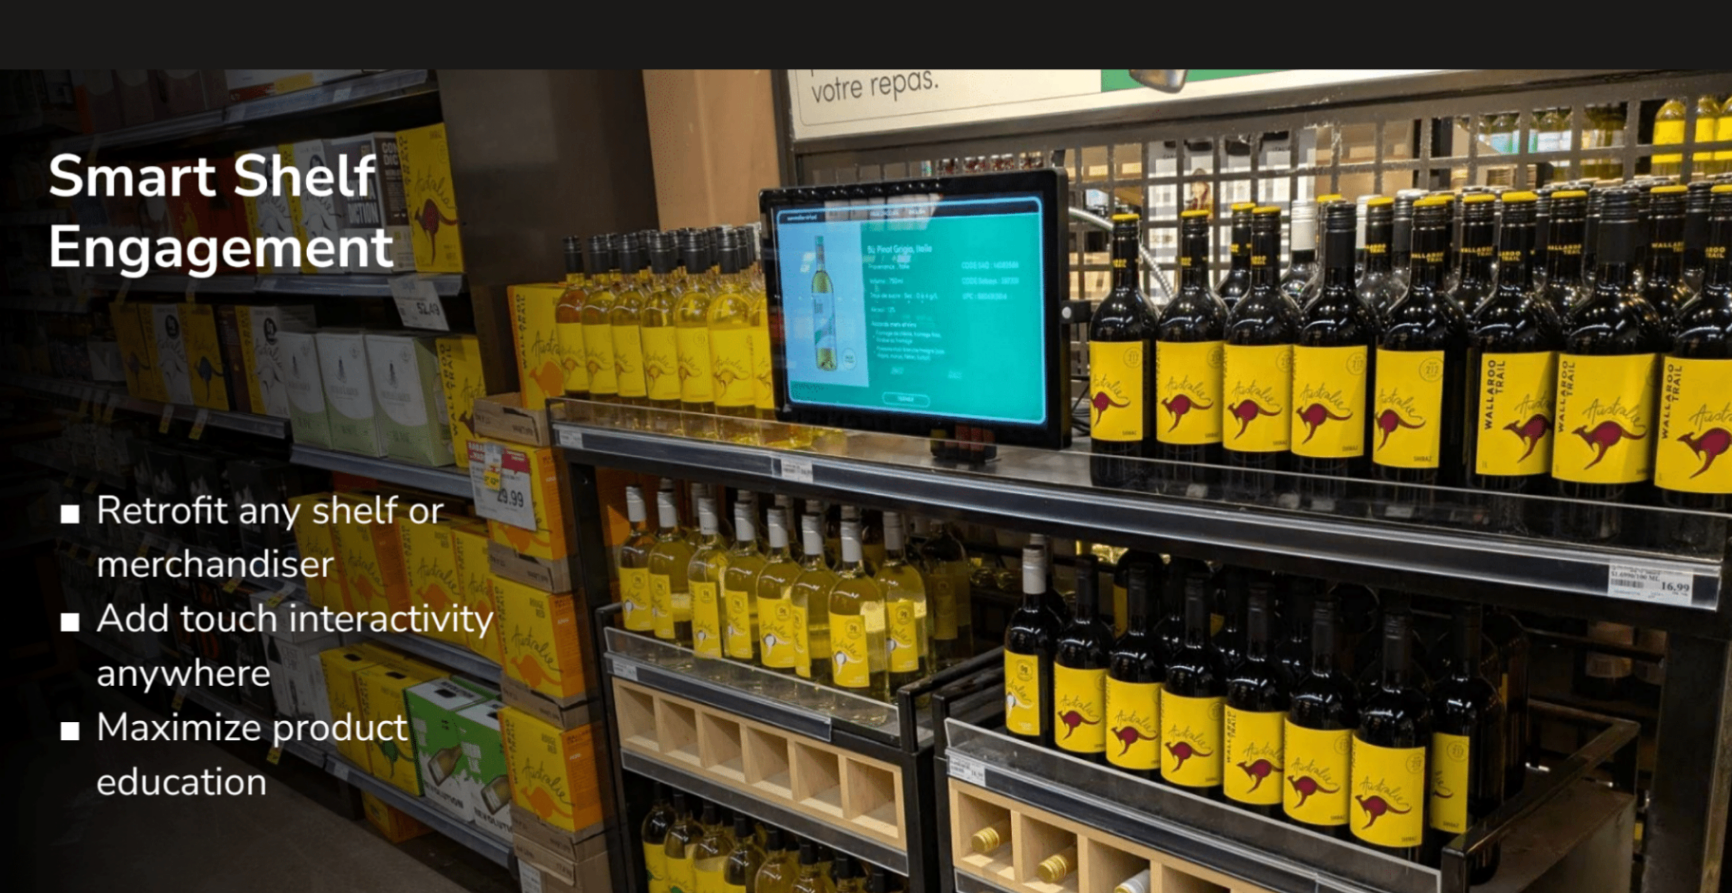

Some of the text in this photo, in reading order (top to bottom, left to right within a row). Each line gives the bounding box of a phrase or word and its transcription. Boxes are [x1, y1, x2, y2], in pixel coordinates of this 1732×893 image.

[811, 70, 939, 103] votre repas.
[876, 245, 893, 254] Pinot
[445, 345, 456, 390] TRAIL
[1495, 360, 1506, 395] TRAIL
[1566, 361, 1576, 397] TRAIL
[1672, 365, 1683, 403] TRAIL
[439, 344, 458, 436] WALLAROO
[1165, 374, 1212, 403] Australie
[1231, 379, 1280, 408] Australie
[1300, 381, 1351, 411] Australie
[1484, 359, 1497, 430] WALLAROO
[1557, 360, 1569, 433] WALLAROO
[1661, 363, 1675, 440] WALLAROO
[1582, 395, 1647, 429] Australie
[1661, 581, 1690, 592] 16.99
[511, 624, 564, 674] Australie
[1060, 694, 1100, 719] Australie
[1115, 709, 1157, 734] Australie
[1168, 724, 1212, 750] Australie
[522, 757, 576, 807] Australie
[1291, 756, 1339, 787] Australie
[1359, 775, 1410, 808] Australie
